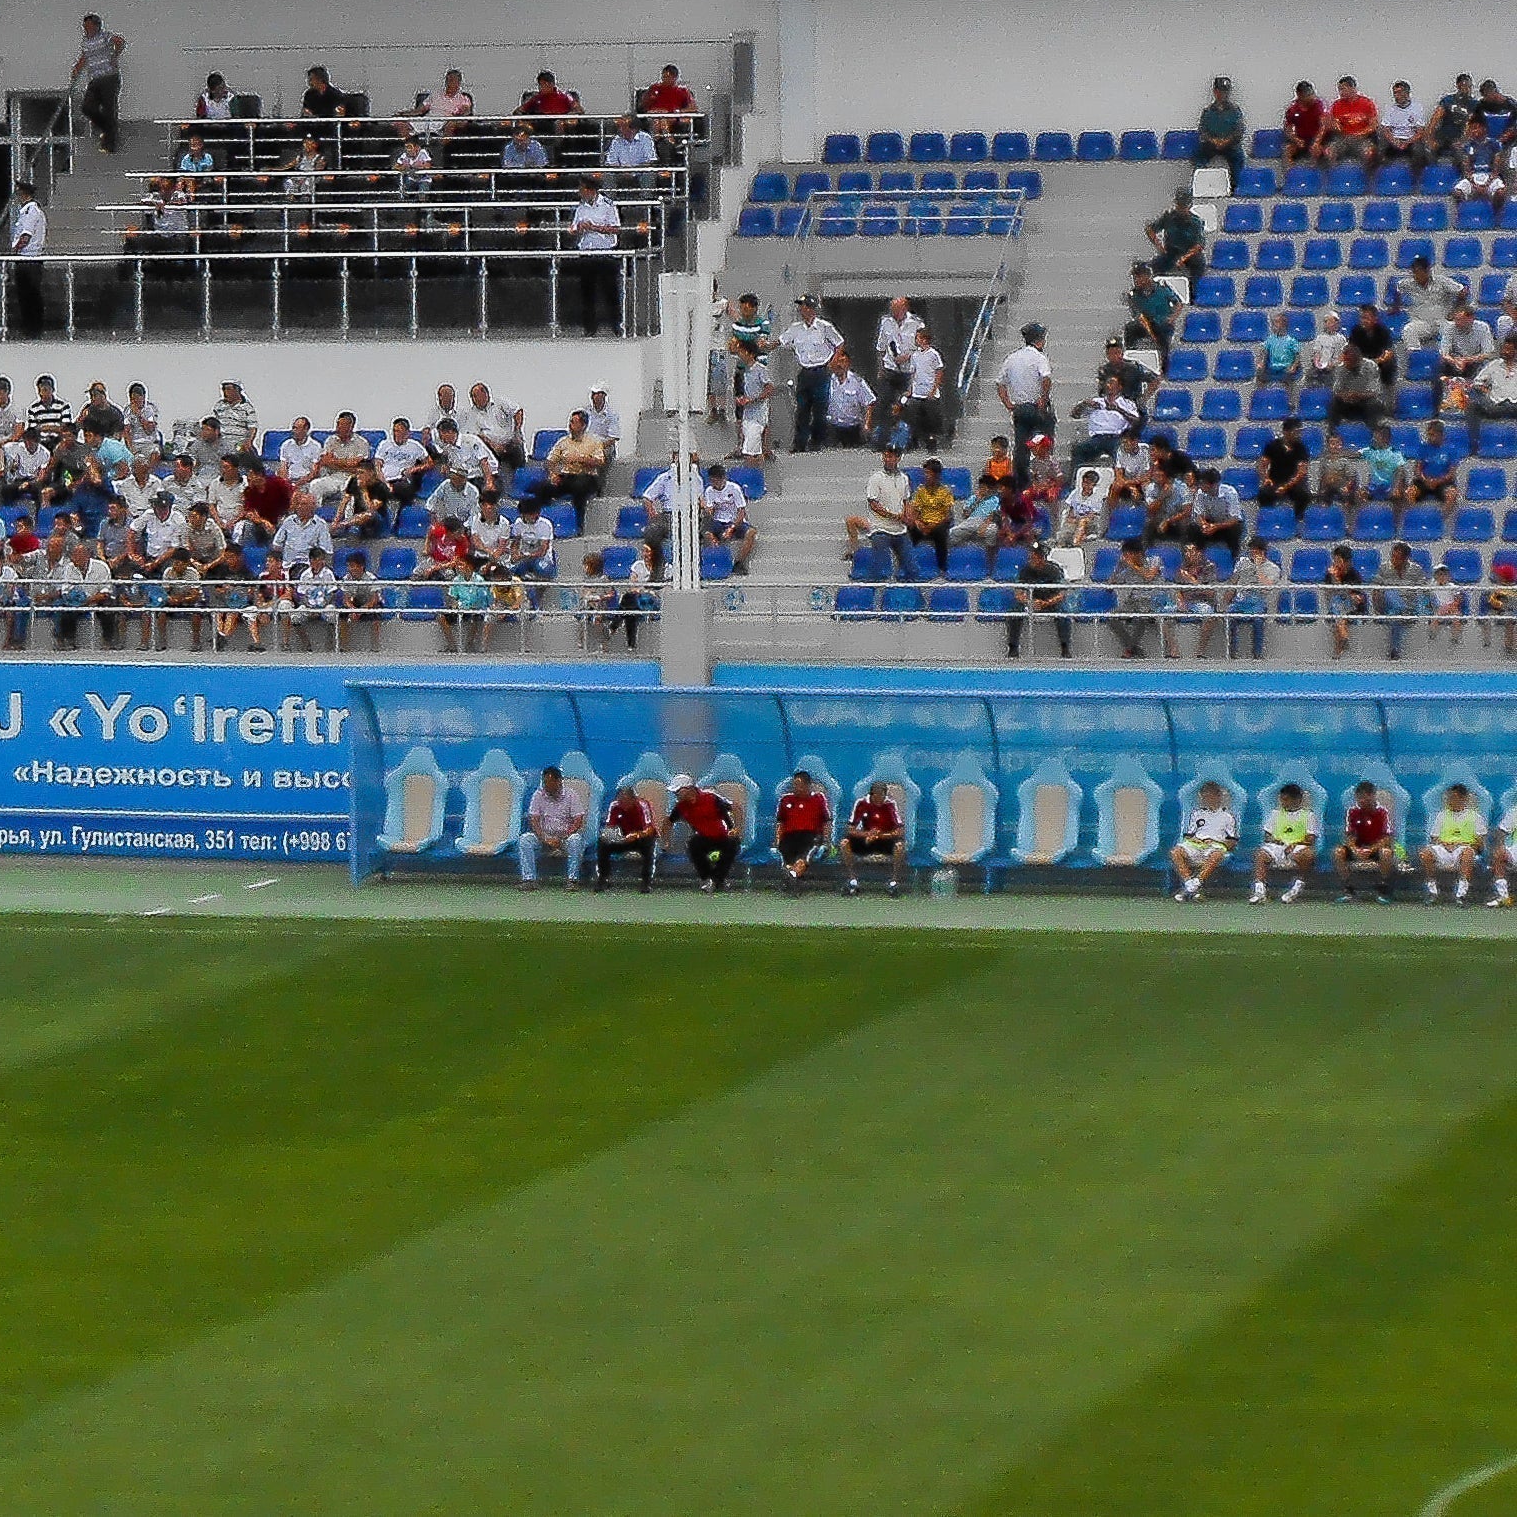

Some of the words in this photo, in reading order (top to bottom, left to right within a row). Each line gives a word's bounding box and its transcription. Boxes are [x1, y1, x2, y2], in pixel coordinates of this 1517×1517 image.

[14, 760, 232, 788] «Надежность
[243, 770, 262, 788] и
[40, 830, 67, 850] ул.
[72, 826, 201, 851] Гулистанская,
[205, 830, 234, 850] 351
[240, 835, 277, 851] тел:
[282, 830, 331, 856] (+998
